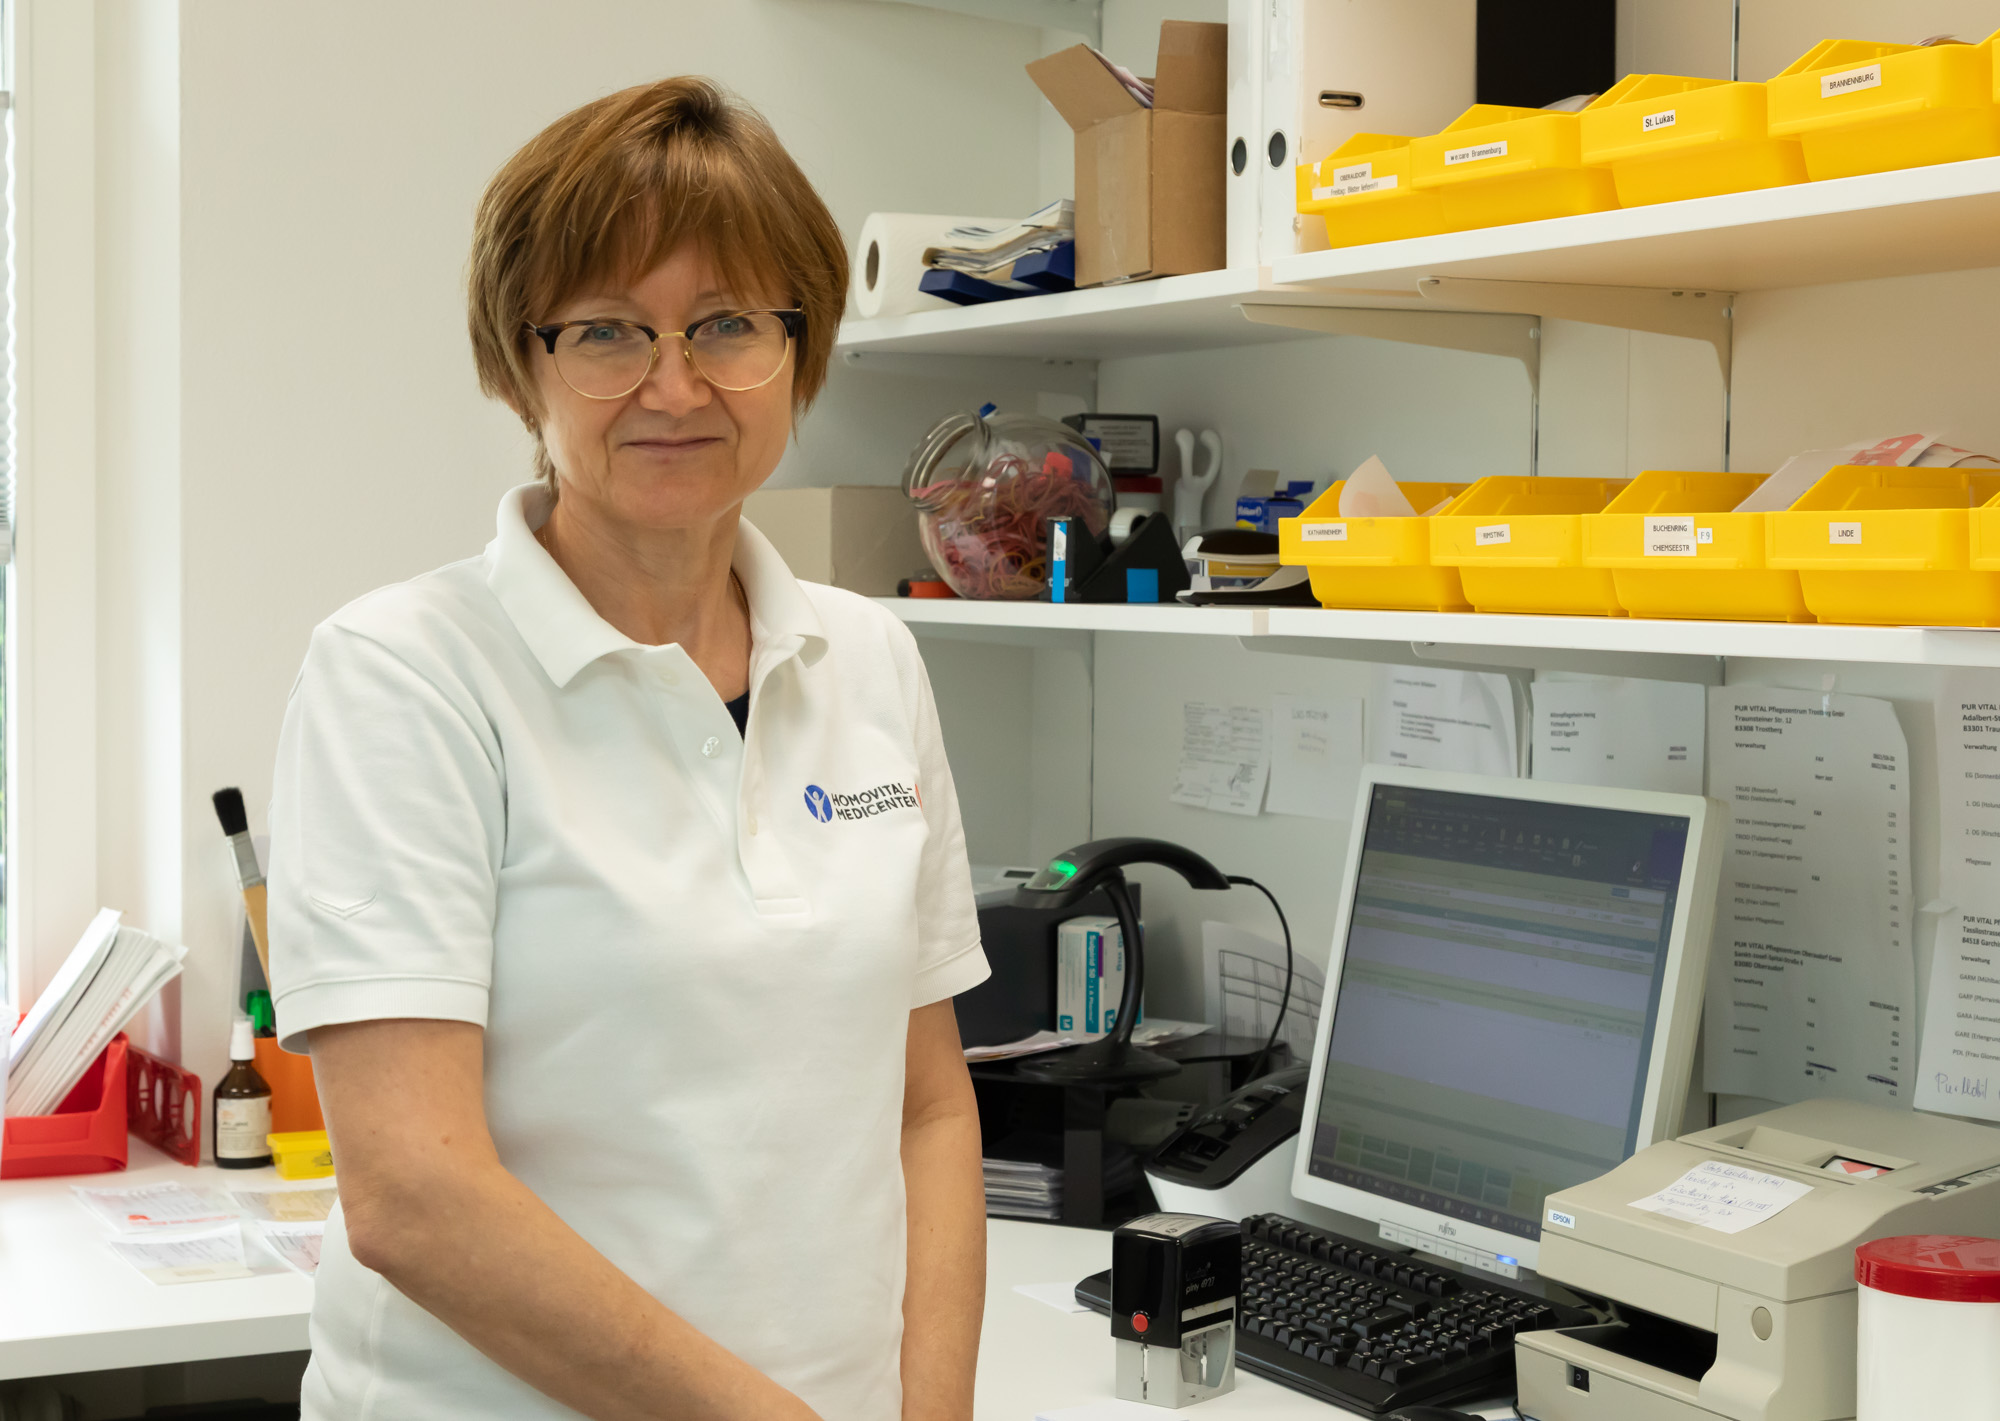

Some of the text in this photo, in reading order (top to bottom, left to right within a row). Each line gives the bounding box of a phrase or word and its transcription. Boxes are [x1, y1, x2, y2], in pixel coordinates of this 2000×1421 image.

[1655, 114, 1675, 126] Lukas
[1652, 524, 1688, 532] BUCHENRING
[1838, 529, 1854, 538] LINDE
[1749, 705, 1767, 713] VITAL
[1961, 703, 1977, 711] PUR
[1963, 743, 1998, 752] Verwaltung
[831, 782, 913, 807] HOMOVITAL-
[835, 795, 919, 820] MEDICENTER
[1963, 915, 1976, 923] PUR
[1976, 916, 1993, 925] VITAL
[1961, 954, 1991, 966] Verwaltung
[1552, 1212, 1571, 1225] EPSON
[1438, 1222, 1457, 1237] FUJITSU
